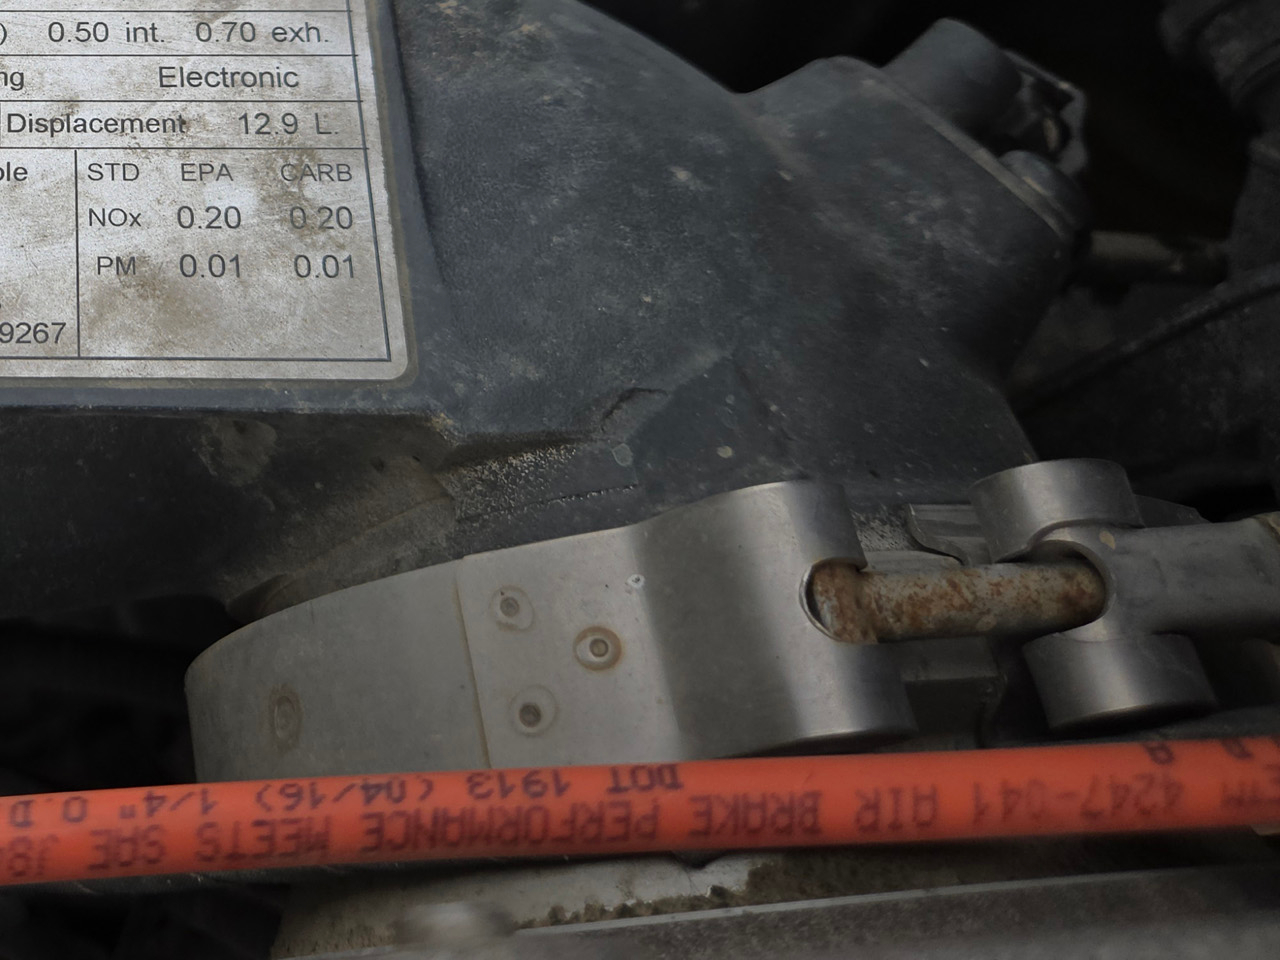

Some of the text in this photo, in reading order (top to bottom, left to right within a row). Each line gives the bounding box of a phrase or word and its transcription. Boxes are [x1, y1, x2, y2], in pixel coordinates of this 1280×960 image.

[48, 22, 110, 43] 0.50
[125, 21, 167, 43] int.
[195, 22, 257, 43] 0.70
[272, 21, 330, 43] exh.
[159, 66, 300, 89] Electronic
[7, 112, 339, 138] Displacement 12.9 L.
[87, 162, 353, 183] STD EPA CARB
[88, 207, 142, 228] NOx
[176, 205, 242, 230] 0.20
[97, 253, 355, 279] PM 0.01 0.01
[467, 768, 570, 800] 1913
[605, 762, 685, 795] DOT
[686, 789, 820, 841] BRAKE
[852, 784, 939, 832] AIR
[195, 813, 330, 864] MEETS
[359, 796, 662, 855] PERFORMANCE
[86, 822, 167, 871] SAE
